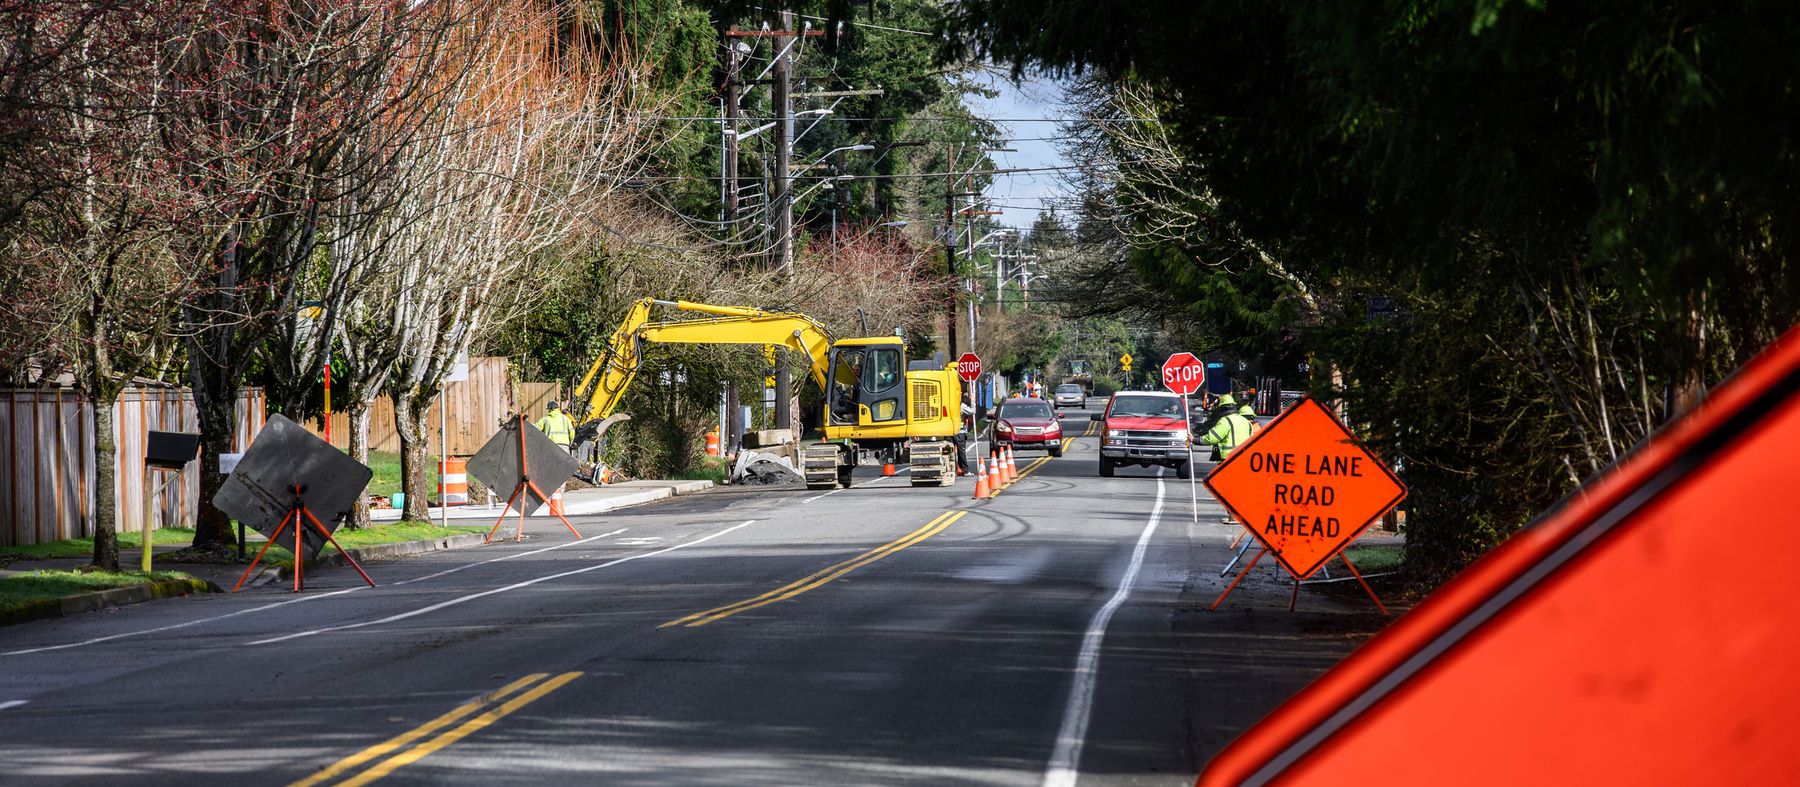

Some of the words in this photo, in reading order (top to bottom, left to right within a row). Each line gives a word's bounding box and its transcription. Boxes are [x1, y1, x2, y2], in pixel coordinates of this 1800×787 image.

[959, 361, 980, 373] STOP
[1165, 364, 1201, 383] STOP
[1249, 452, 1295, 474] ONE
[1305, 454, 1363, 477] LANE
[1274, 484, 1335, 506] ROAD
[1264, 514, 1340, 538] AHEAD
